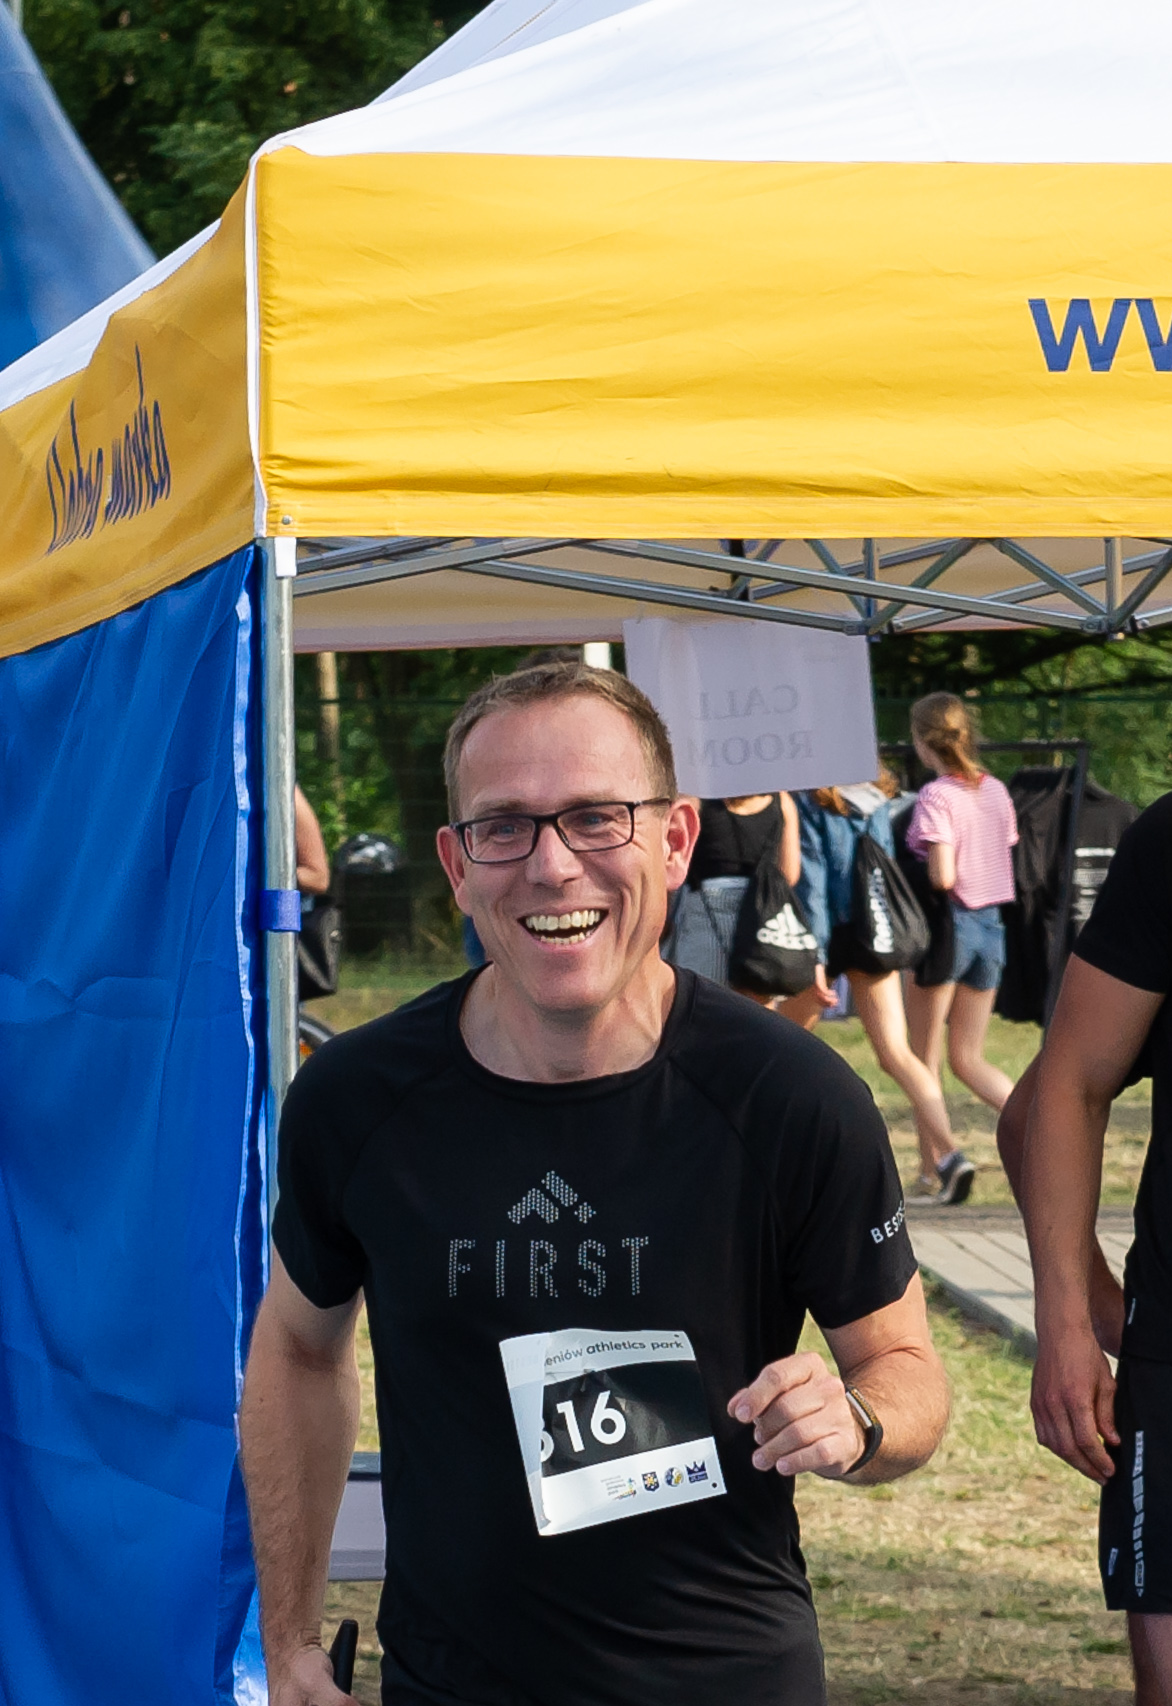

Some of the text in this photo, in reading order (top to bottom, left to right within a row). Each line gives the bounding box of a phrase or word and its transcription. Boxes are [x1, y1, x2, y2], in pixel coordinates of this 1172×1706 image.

[449, 1236, 649, 1298] FIRST
[586, 1340, 646, 1355] athletics
[651, 1339, 684, 1351] park
